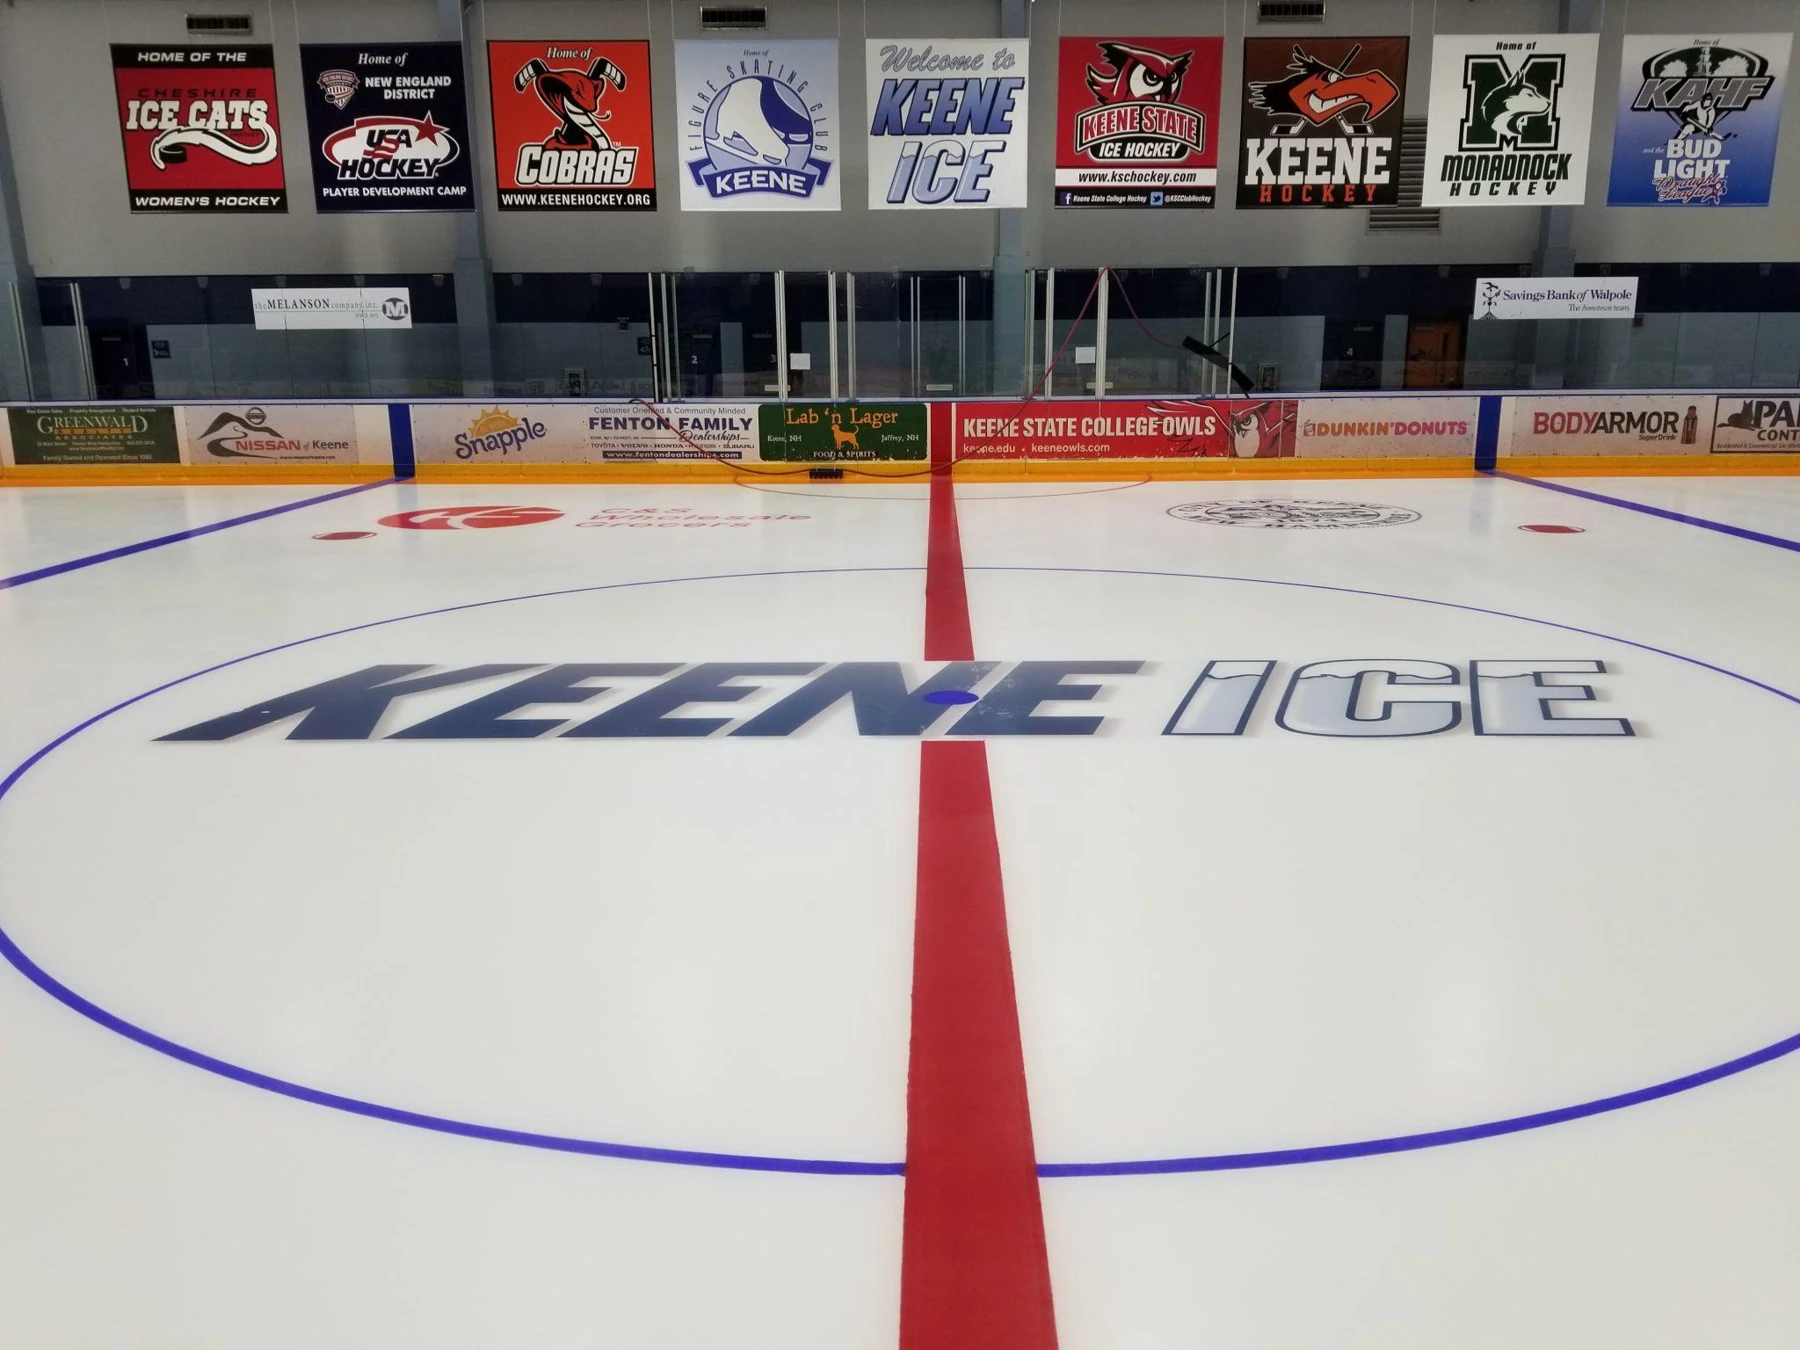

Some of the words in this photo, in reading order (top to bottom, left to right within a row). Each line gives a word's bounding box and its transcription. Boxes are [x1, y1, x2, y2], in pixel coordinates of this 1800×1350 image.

[1496, 42, 1523, 50] Home
[1526, 42, 1536, 50] of
[1712, 38, 1720, 46] of
[138, 52, 184, 62] HOME
[190, 52, 211, 62] OF
[217, 52, 247, 62] THE
[358, 53, 392, 65] Home
[394, 52, 408, 67] of
[546, 47, 578, 58] Home
[580, 46, 594, 61] of
[762, 49, 770, 58] of
[880, 44, 984, 72] Welcome
[992, 47, 1016, 71] to
[365, 77, 394, 88] NEW
[396, 76, 452, 87] ENGLAND
[138, 88, 257, 98] CHESHIRE
[384, 88, 436, 100] DISTRICT
[1632, 77, 1773, 110] KAHF
[688, 80, 718, 151] FIGURE
[726, 59, 808, 94] SKATING
[810, 102, 828, 152] CLUB
[870, 77, 1025, 136] KEENE
[126, 100, 180, 130] ICE
[188, 100, 269, 130] CATS
[1083, 106, 1140, 144] KEENE
[1142, 106, 1198, 144] STATE
[364, 129, 412, 154] USA
[1666, 139, 1722, 158] BUD
[1099, 142, 1122, 157] ICE
[1124, 142, 1180, 157] HOCKEY
[338, 158, 441, 179] HOCKEY
[516, 145, 638, 185] COBRAS
[1245, 138, 1392, 185] KEENE
[1440, 154, 1572, 182] MONADNOCK
[886, 140, 1007, 204] ICE
[1654, 160, 1730, 179] LIGHT
[716, 170, 806, 195] KEENE
[1078, 171, 1196, 185] www.kschockey.com
[322, 188, 360, 197] PLAYER
[362, 187, 434, 196] DEVELOPMENT
[437, 186, 467, 196] CAMP
[1260, 184, 1377, 203] HOCKEY
[1449, 182, 1556, 196] HOCKEY
[136, 196, 210, 206] WOMEN'S
[215, 196, 280, 206] HOCKEY
[501, 194, 650, 206] WWW.KEENEHOCKEY.ORG
[1073, 194, 1090, 202] Keene
[1091, 194, 1106, 202] State
[1106, 194, 1126, 204] College
[1127, 194, 1148, 204] Hockey
[1503, 290, 1546, 302] Savings
[1547, 290, 1576, 300] Bank
[1576, 290, 1588, 303] of
[1590, 290, 1632, 302] Walpole
[255, 301, 266, 310] the
[267, 299, 330, 310] MELANSON
[1568, 304, 1580, 312] The
[770, 354, 776, 362] 3
[1347, 348, 1354, 356] 4
[123, 358, 128, 366] 1
[692, 356, 698, 364] 2
[674, 407, 716, 416] Community
[786, 408, 819, 424] Lab
[850, 408, 898, 429] Lager
[1754, 400, 1800, 428] PA
[37, 416, 148, 434] GREENWALD
[589, 417, 670, 430] FENTON
[678, 418, 753, 430] FAMILY
[964, 418, 1020, 438] KEENE
[1023, 418, 1076, 437] STATE
[1081, 417, 1158, 437] COLLEGE
[1162, 416, 1216, 436] OWLS
[1394, 422, 1468, 436] DONUTS
[1533, 412, 1679, 434] BODYARMOR
[454, 417, 547, 459] Snapple
[678, 430, 741, 445] Dealerships
[881, 434, 904, 442] Jaffrey,
[236, 440, 300, 450] NISSAN
[312, 440, 348, 450] Keene
[1032, 443, 1110, 452] keeneowls.com
[846, 450, 876, 458] SPIRITS
[150, 659, 1150, 742] KEENE
[1161, 658, 1637, 738] ICE
